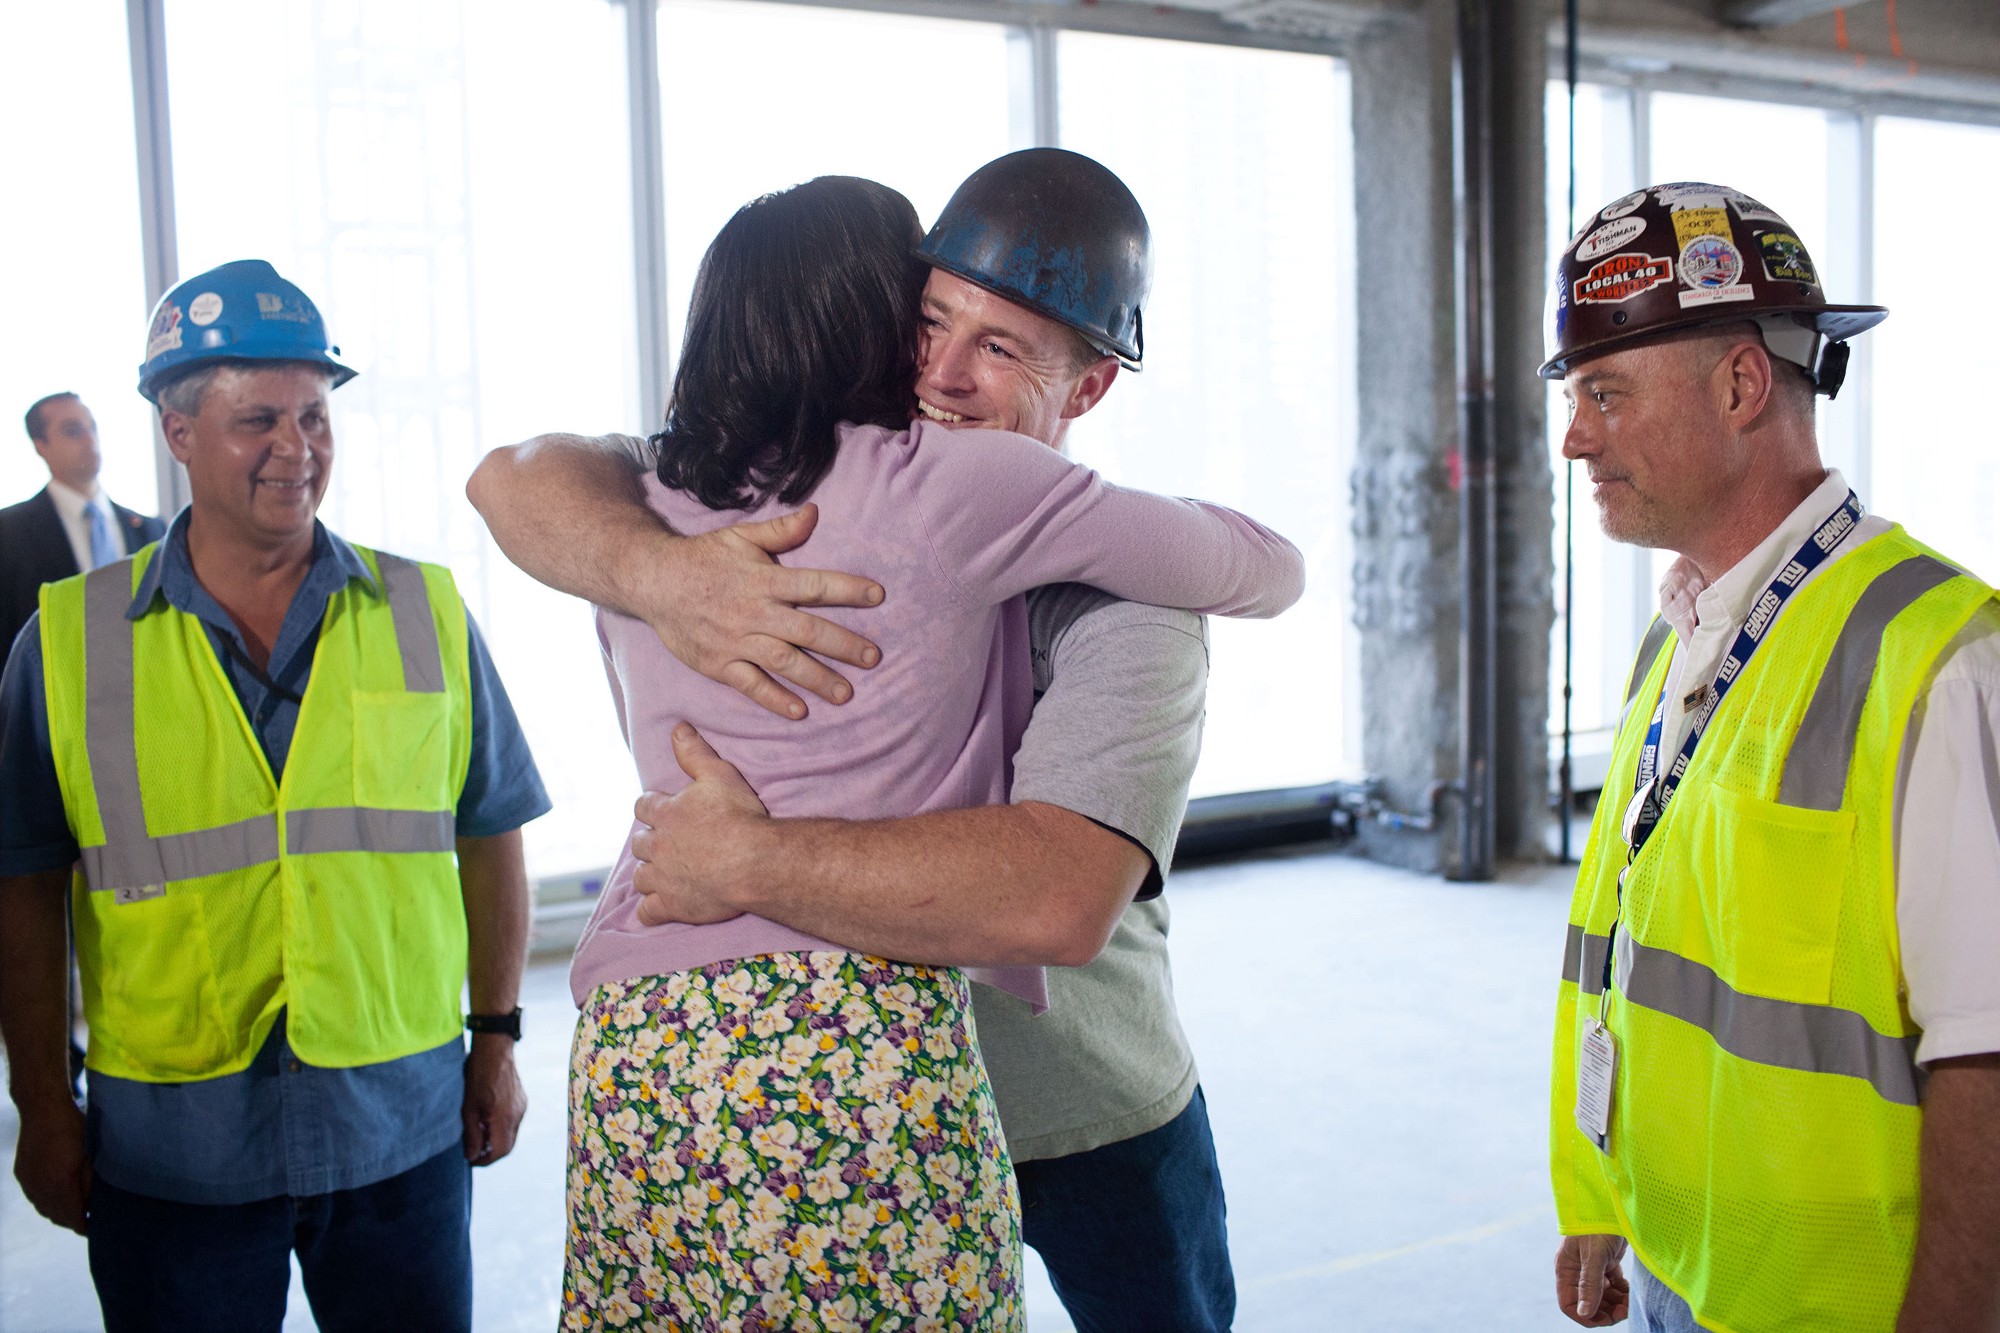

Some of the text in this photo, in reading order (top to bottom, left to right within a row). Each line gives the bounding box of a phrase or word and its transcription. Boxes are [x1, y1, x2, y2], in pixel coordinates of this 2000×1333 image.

[1585, 271, 1632, 293] LOCAL
[1634, 266, 1657, 279] 40
[1598, 256, 1640, 278] IRON
[1813, 508, 1855, 554] GIANTS
[1743, 589, 1782, 642] GIANTS
